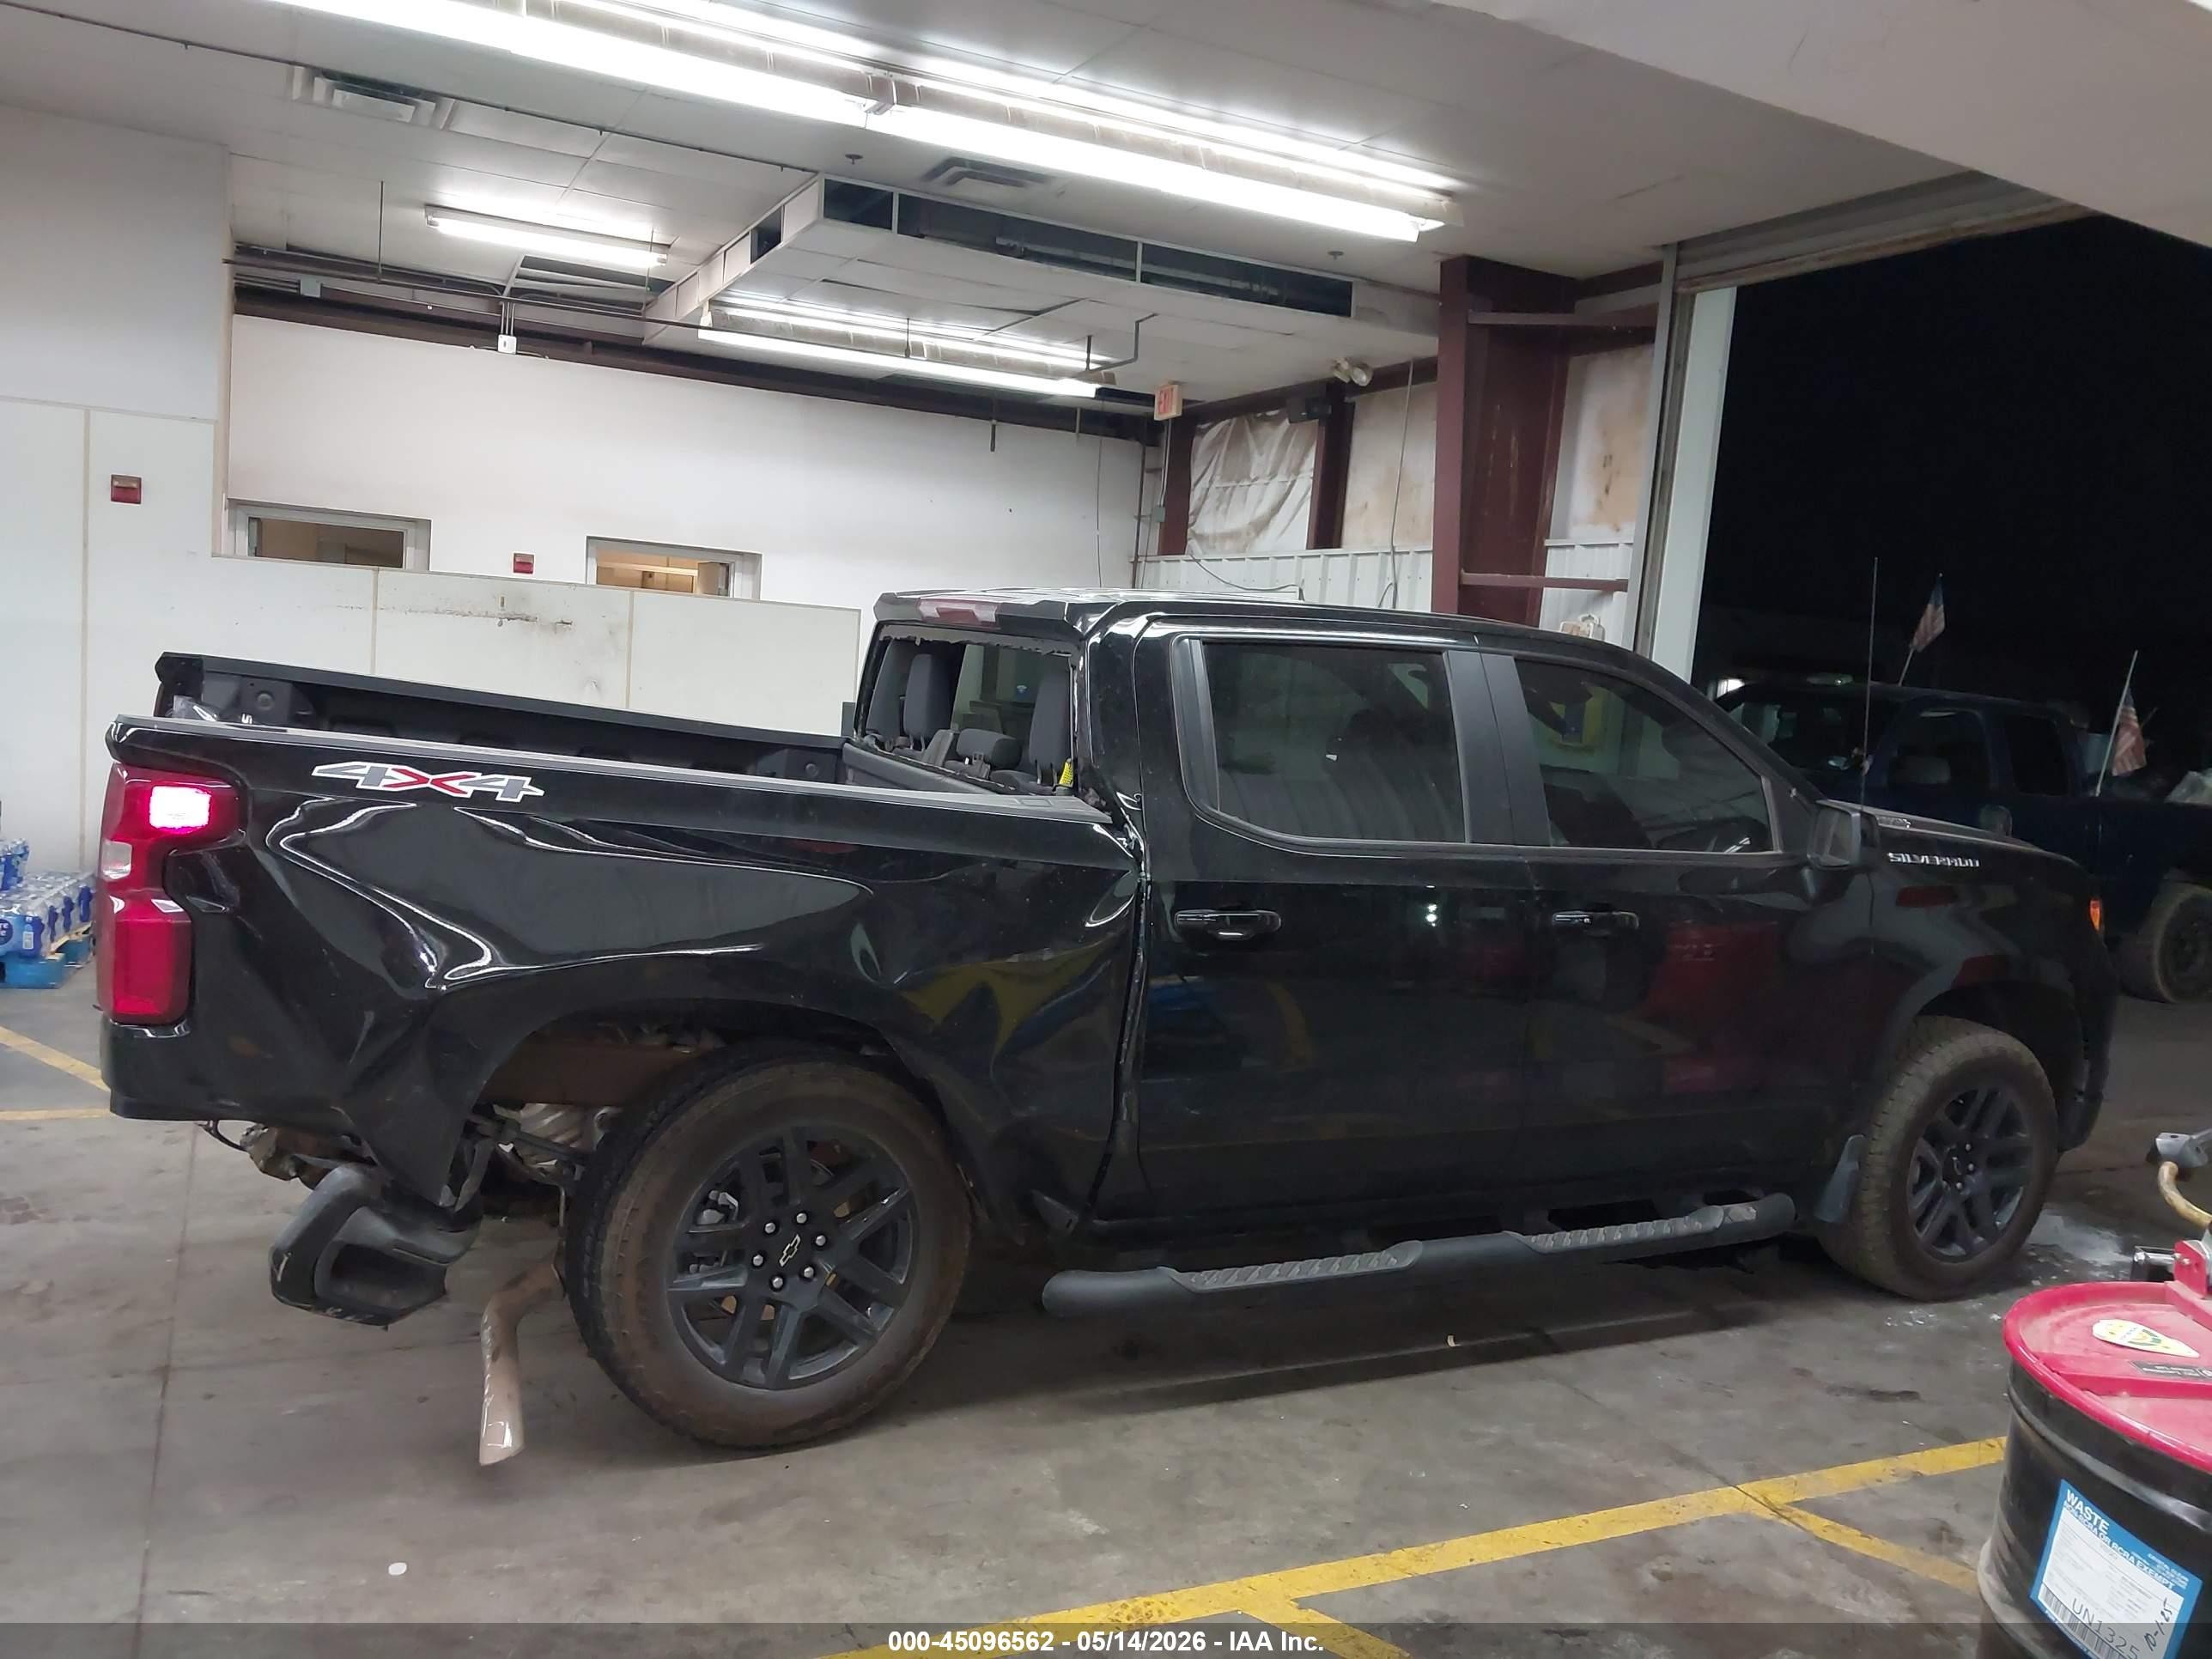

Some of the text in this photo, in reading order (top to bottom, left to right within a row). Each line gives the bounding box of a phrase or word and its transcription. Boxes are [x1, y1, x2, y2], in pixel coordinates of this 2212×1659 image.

[2067, 1489, 2109, 1535] WASTE
[2112, 1541, 2136, 1564] RCRA
[2136, 1559, 2176, 1589] EXEMPT
[2072, 1597, 2140, 1659] UN1325
